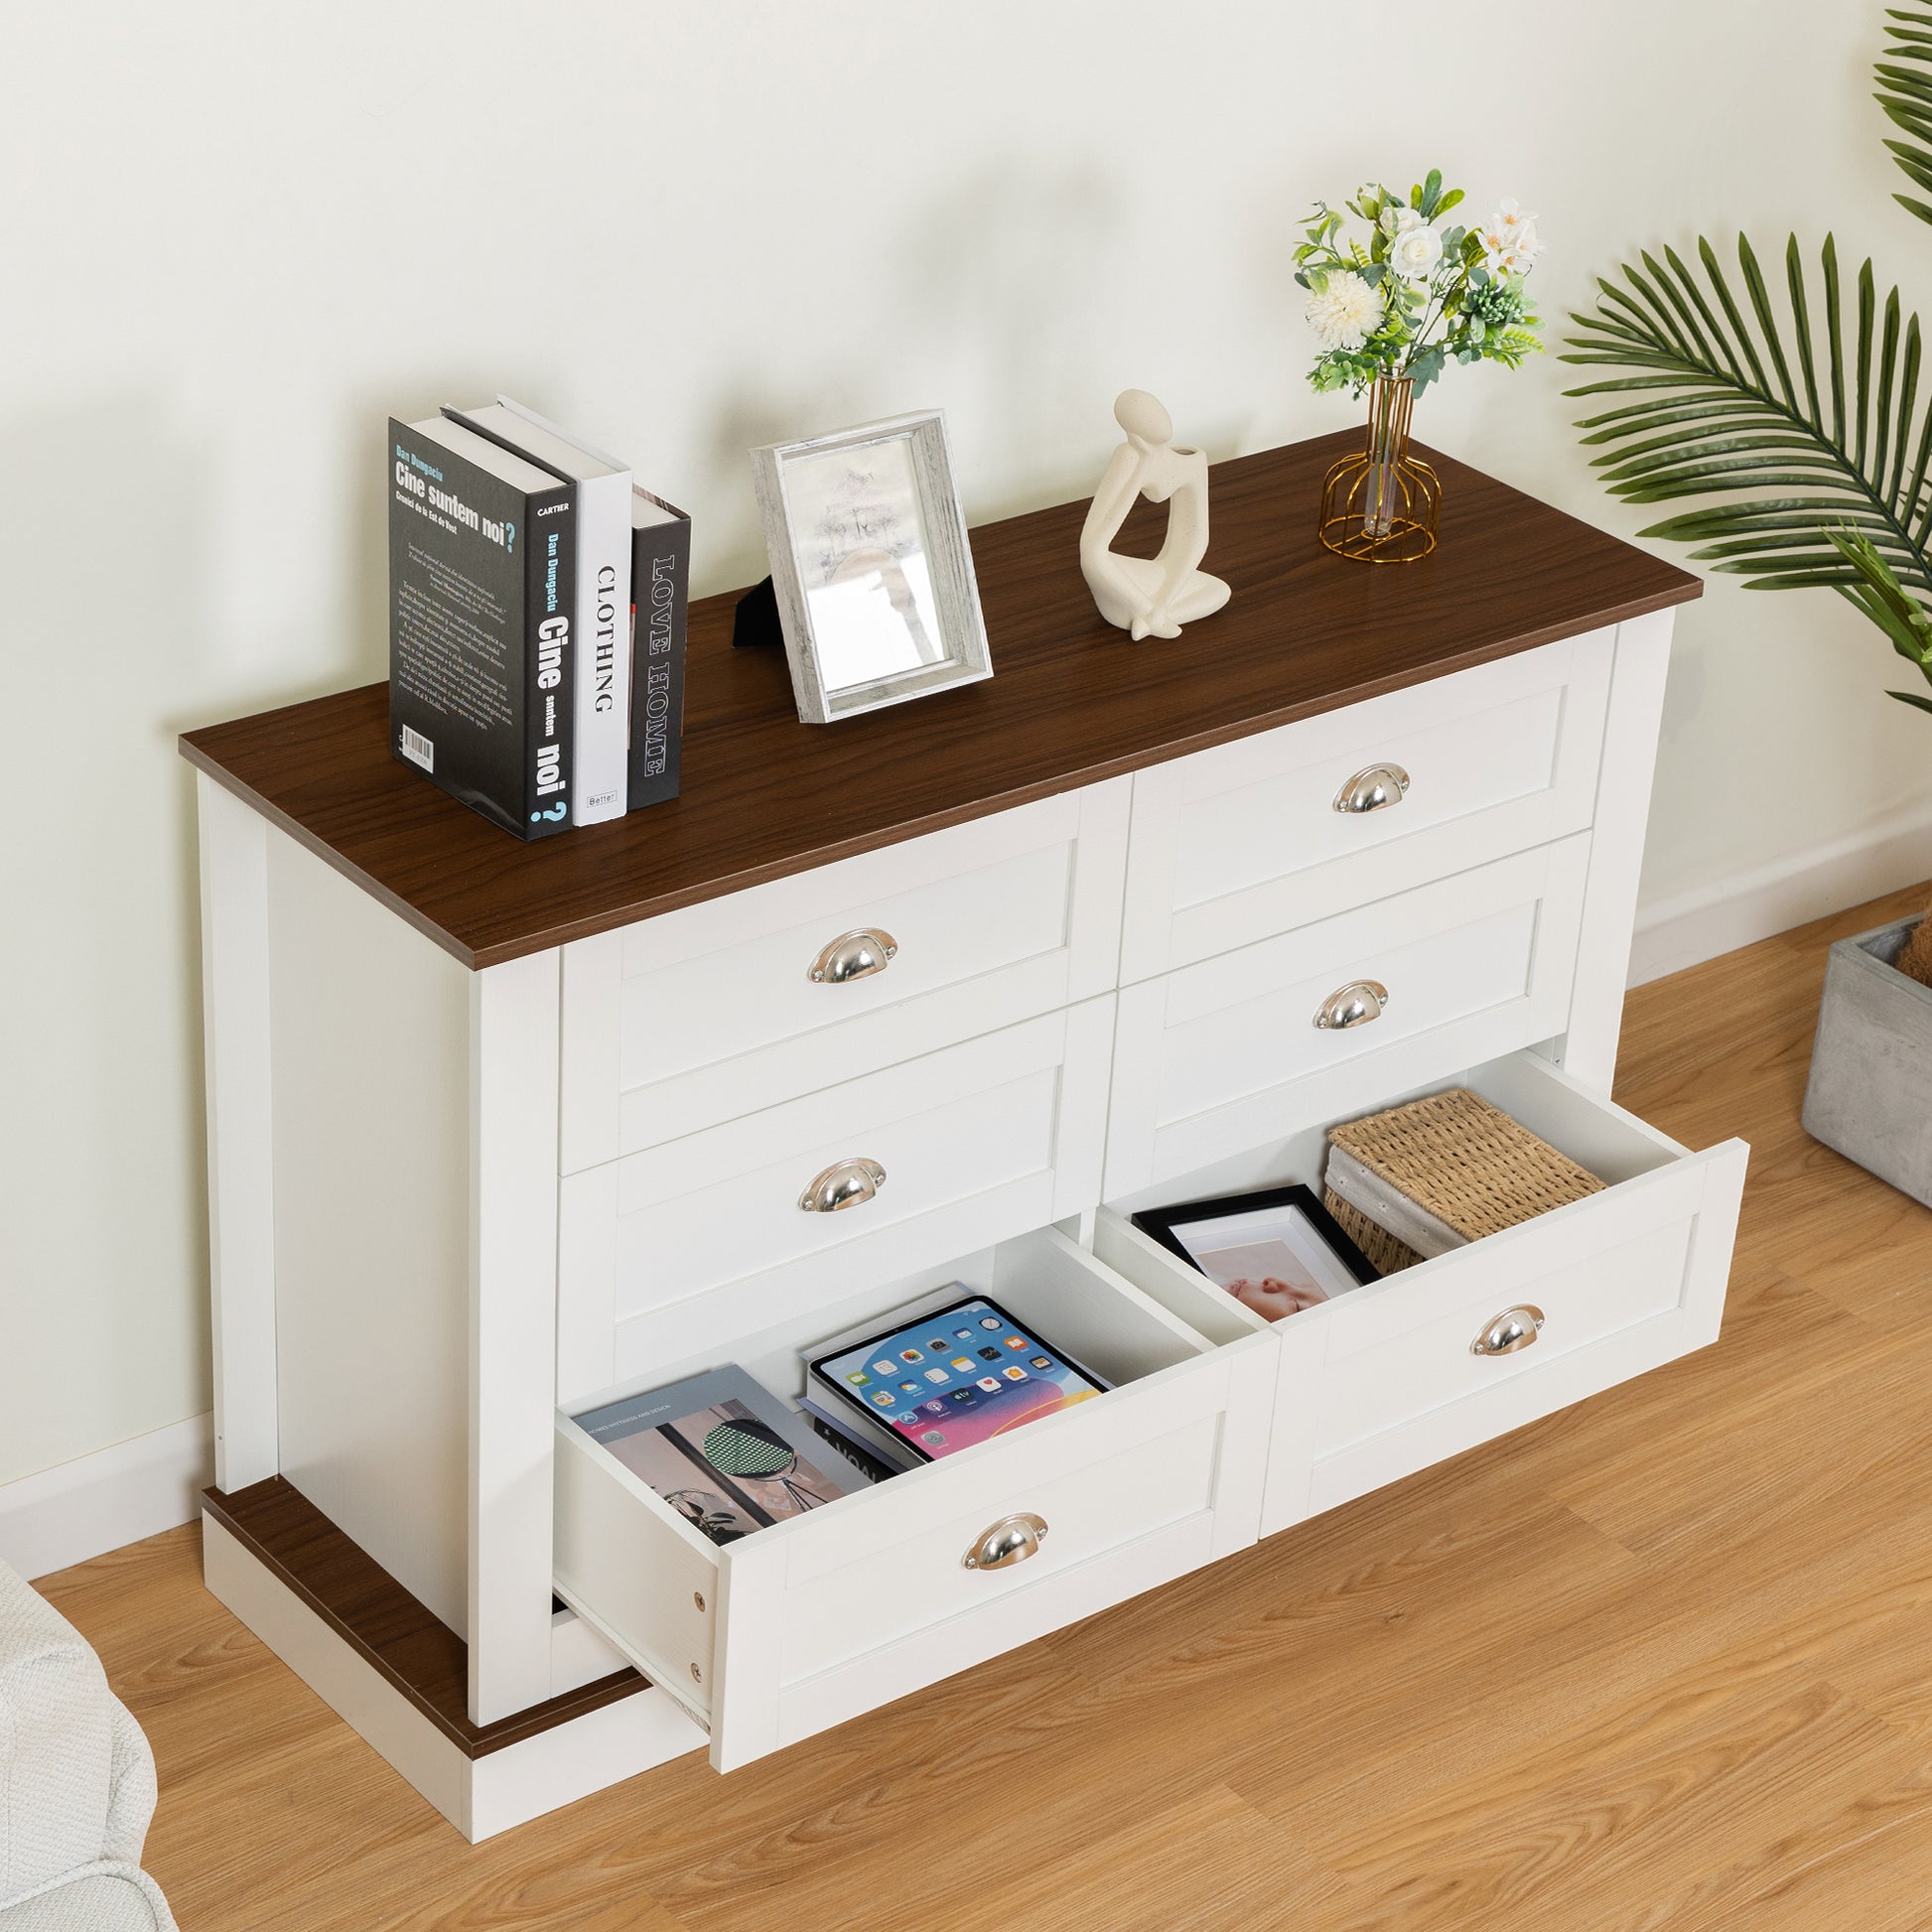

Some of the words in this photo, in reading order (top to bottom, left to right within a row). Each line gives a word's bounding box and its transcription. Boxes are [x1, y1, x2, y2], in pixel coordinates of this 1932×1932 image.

[396, 461, 425, 498] Cine
[428, 485, 479, 531] suntem
[537, 502, 570, 516] CARTIER
[548, 533, 559, 557] Dan
[545, 558, 559, 613] Dungaciu
[649, 554, 675, 656] LOVE
[537, 616, 569, 689] Cine
[596, 565, 617, 714] CLOTHING
[545, 695, 555, 737] suntem
[644, 662, 670, 777] HOME
